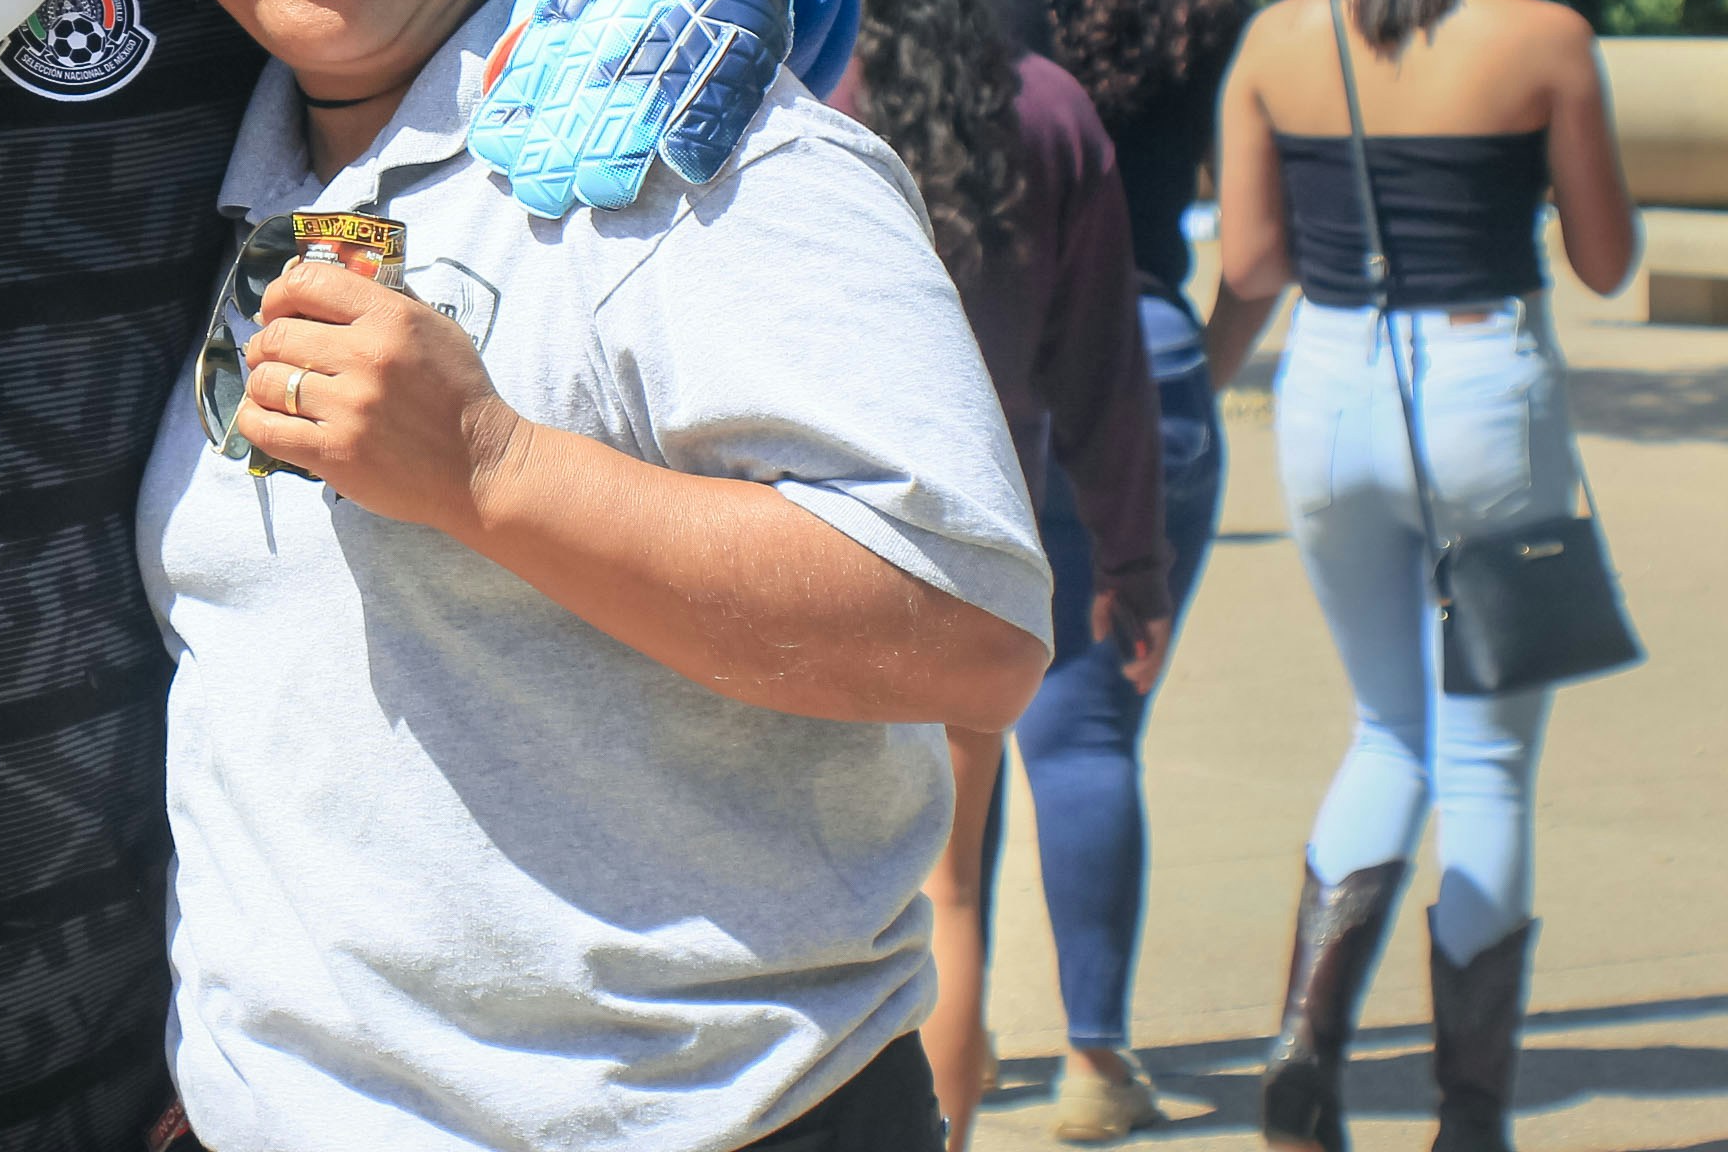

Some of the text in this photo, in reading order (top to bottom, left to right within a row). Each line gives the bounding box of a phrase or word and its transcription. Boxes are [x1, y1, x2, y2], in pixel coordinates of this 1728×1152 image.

[21, 39, 137, 81] SELECCIÓN NACIONAL DE MÉXICO
